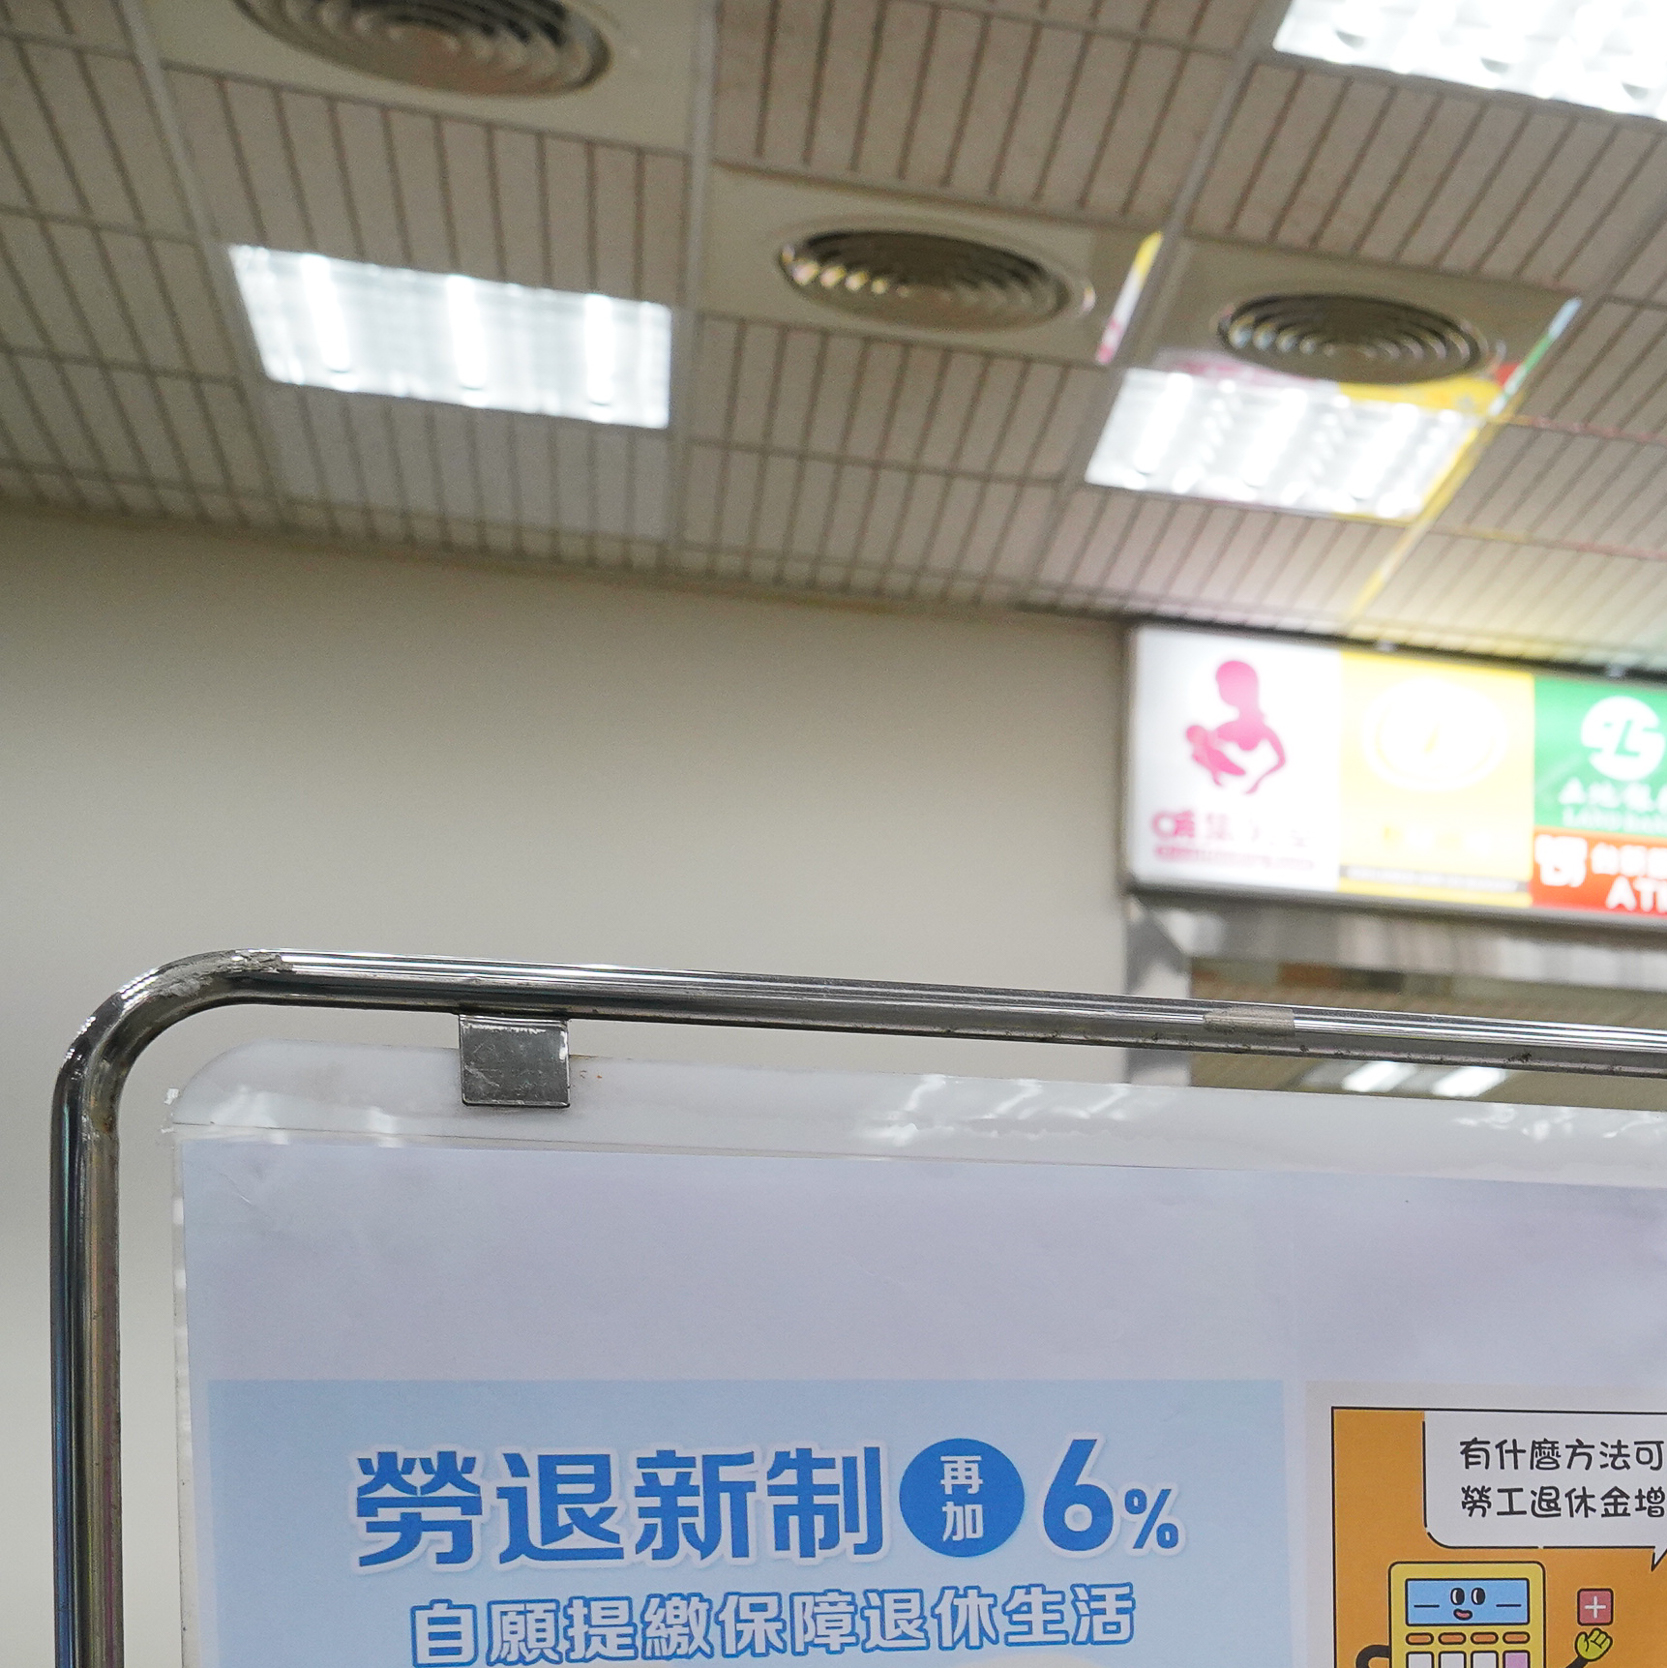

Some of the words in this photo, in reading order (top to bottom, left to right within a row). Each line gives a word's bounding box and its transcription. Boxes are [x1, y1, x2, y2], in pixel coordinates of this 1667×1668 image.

[356, 1446, 884, 1566] 勞退新制
[937, 1455, 986, 1543] 再加
[1041, 1437, 1181, 1555] 6%
[409, 1582, 1137, 1668] 自願提繳保障退休生活
